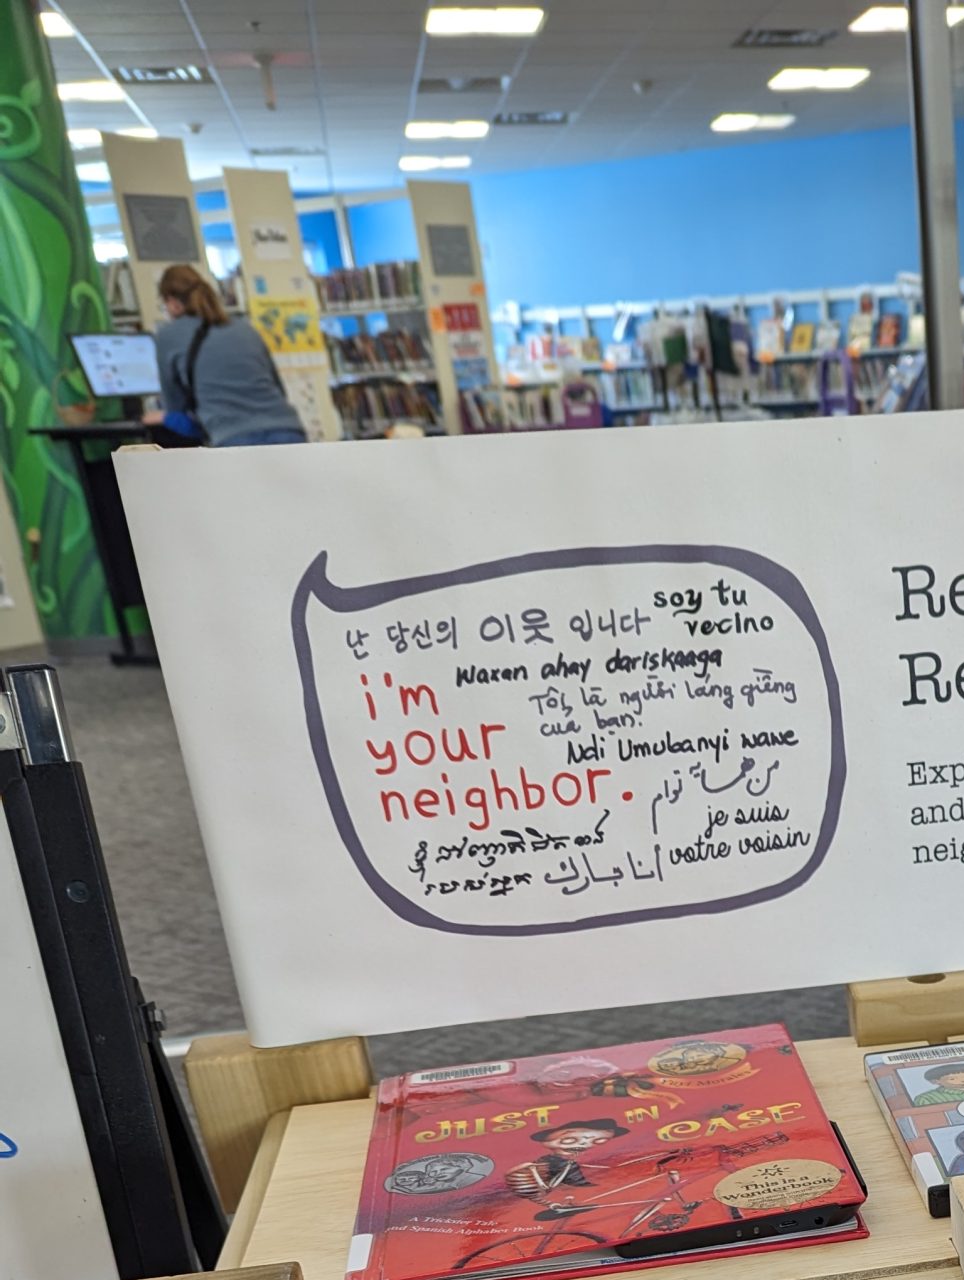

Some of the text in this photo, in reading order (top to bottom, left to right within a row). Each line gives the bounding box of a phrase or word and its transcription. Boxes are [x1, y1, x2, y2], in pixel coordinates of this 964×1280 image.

[653, 579, 747, 617] soy tu
[387, 617, 457, 653] 당신의
[479, 608, 554, 644] 이웃
[569, 607, 651, 641] 입니다
[541, 652, 591, 683] ahay
[360, 672, 439, 721] i'm
[366, 724, 506, 775] your
[567, 733, 605, 765] Ndi
[704, 801, 790, 840] je suis
[669, 826, 811, 865] votre voisin
[415, 1102, 806, 1143] JUST IN CASE
[723, 1177, 834, 1201] Wonderbook
[741, 1180, 779, 1191] This
